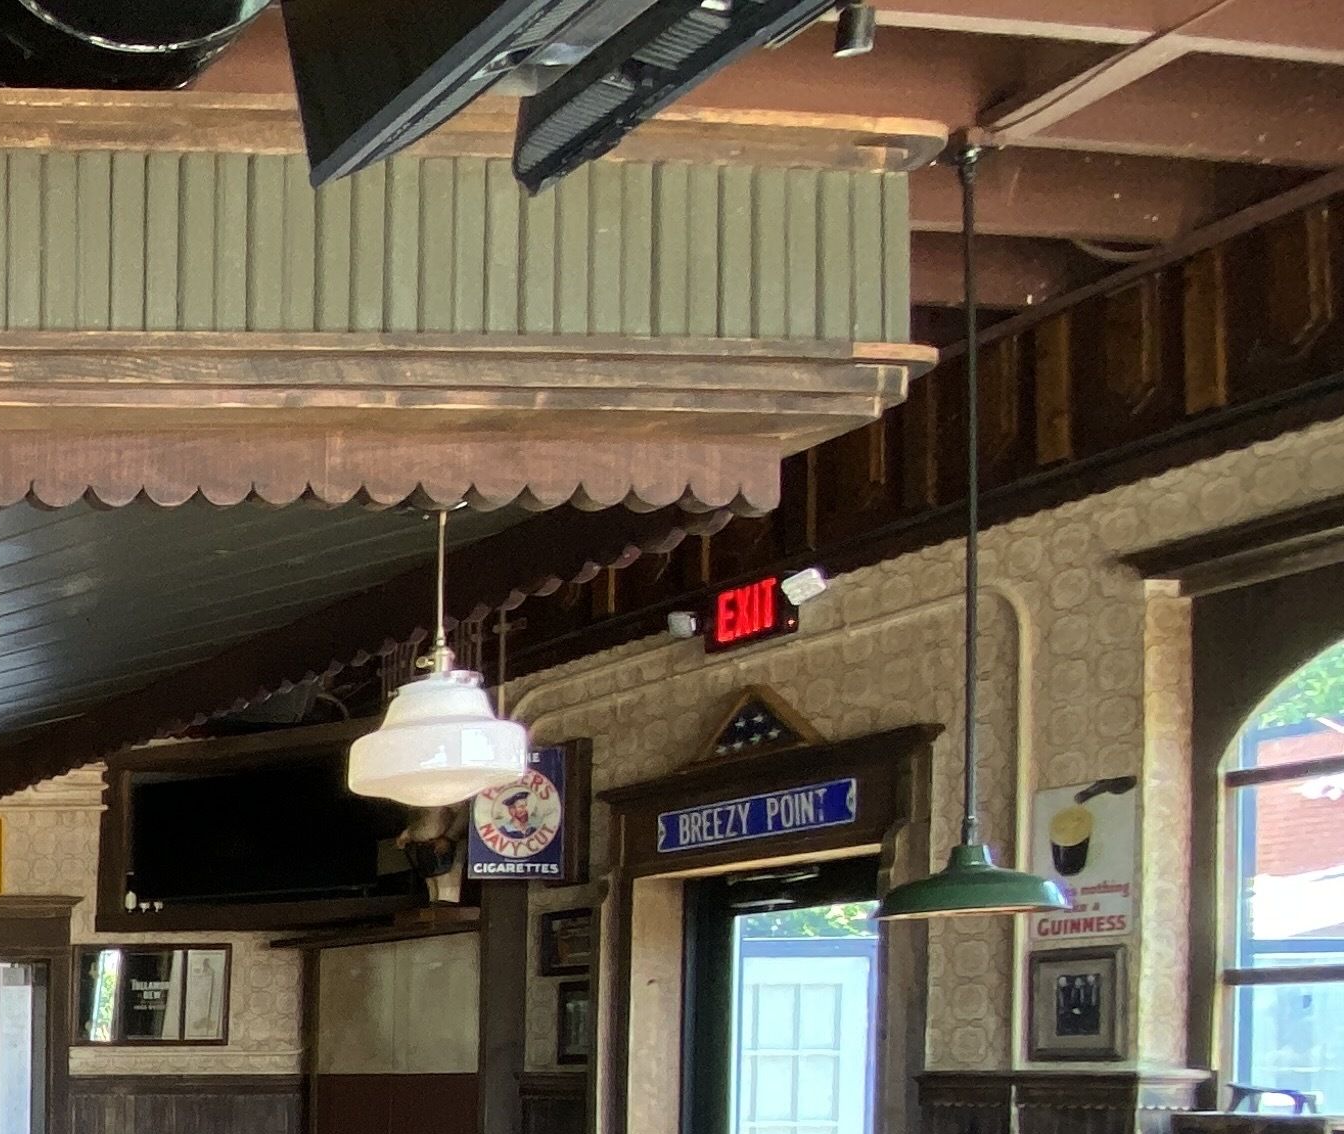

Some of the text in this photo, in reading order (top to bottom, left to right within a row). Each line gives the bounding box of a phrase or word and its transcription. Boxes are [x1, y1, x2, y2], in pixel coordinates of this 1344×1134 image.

[718, 577, 776, 642] EXIT
[678, 788, 828, 846] BREEZY POINT
[480, 823, 554, 857] NAVY CUT
[473, 862, 559, 874] CIGARETTES
[1037, 915, 1126, 936] GUINNESS
